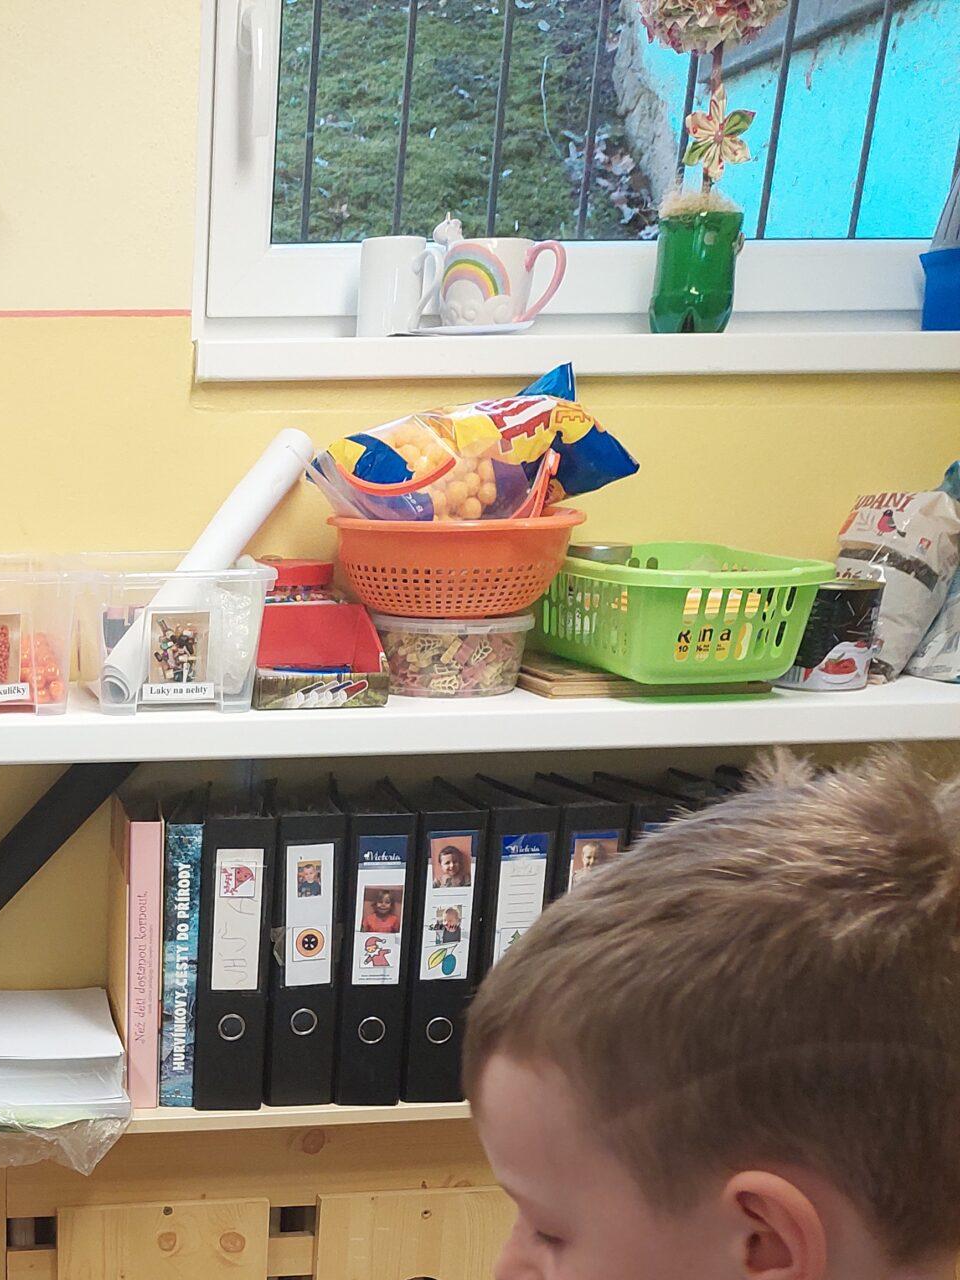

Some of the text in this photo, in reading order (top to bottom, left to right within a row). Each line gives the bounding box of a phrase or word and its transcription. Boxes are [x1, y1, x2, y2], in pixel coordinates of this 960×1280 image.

[150, 686, 172, 696] Laky
[185, 685, 209, 695] nehty
[365, 850, 401, 861] Victoria
[135, 950, 147, 997] dostanou
[171, 861, 193, 1072] HURVÍNKOVY CESTY DO PŘÍRODY
[135, 1022, 146, 1044] Než
